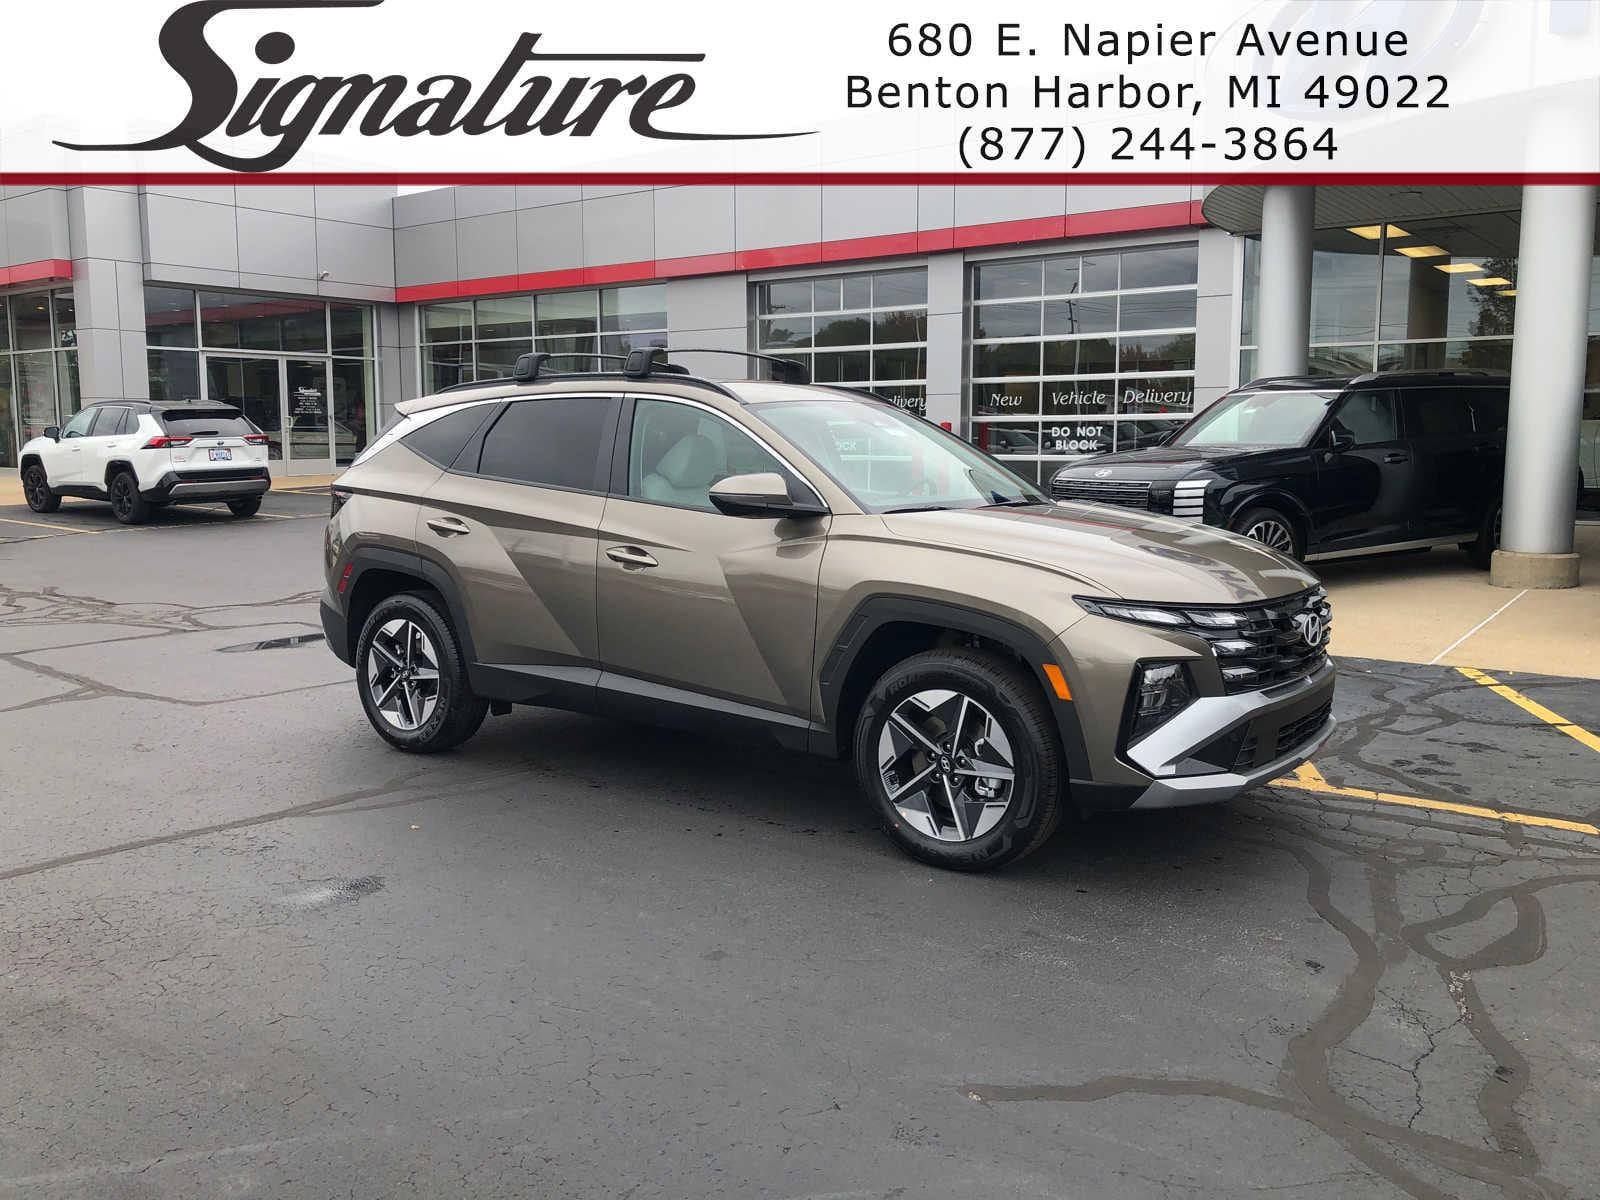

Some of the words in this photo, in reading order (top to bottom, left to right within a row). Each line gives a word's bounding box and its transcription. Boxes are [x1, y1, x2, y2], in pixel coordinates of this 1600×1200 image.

[888, 395, 928, 411] livery
[990, 393, 1022, 407] New
[1052, 390, 1106, 405] Vehicle
[1123, 389, 1193, 406] Delivery
[1051, 426, 1070, 437] DO
[1076, 426, 1103, 437] NOT
[1055, 440, 1098, 451] BLOCK
